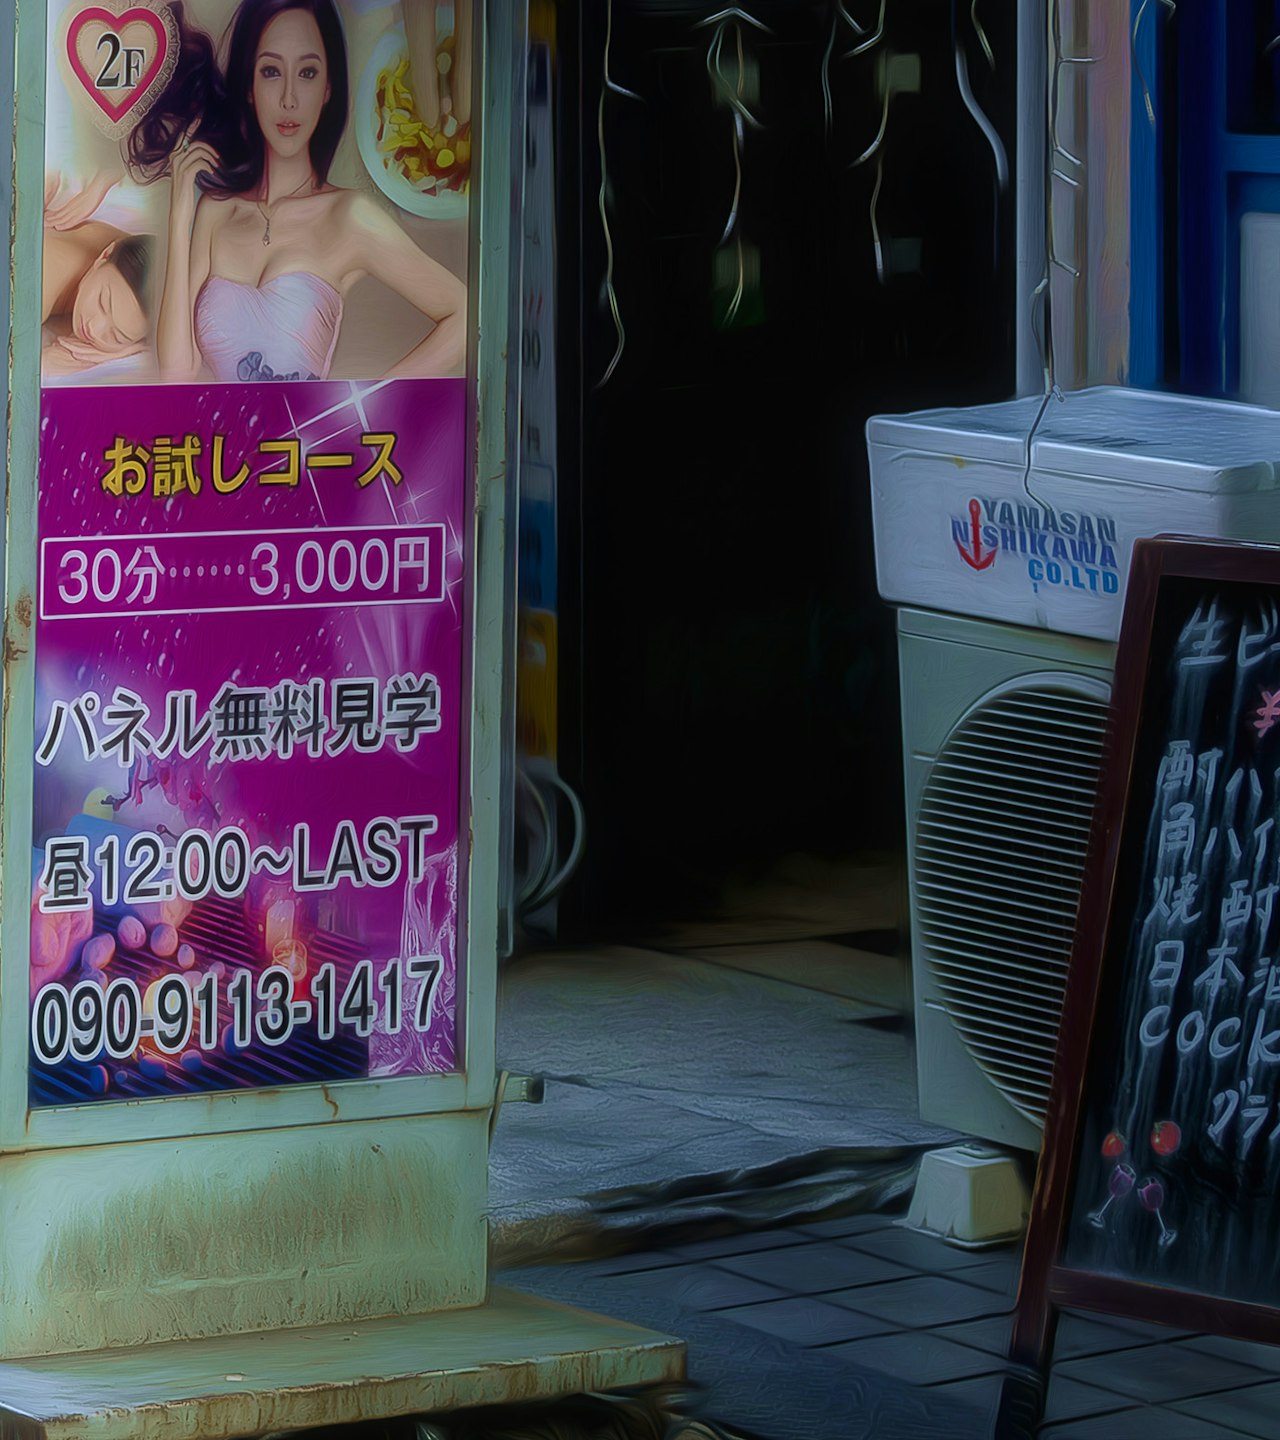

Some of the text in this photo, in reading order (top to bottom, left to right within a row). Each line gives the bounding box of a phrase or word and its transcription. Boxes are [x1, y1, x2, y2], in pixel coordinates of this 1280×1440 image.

[94, 32, 145, 88] 2F
[100, 432, 403, 497] お試しコース
[983, 500, 1117, 542] YAMASAN
[1028, 558, 1118, 595] CO.LTD
[35, 671, 442, 767] パネル無料見学
[1157, 740, 1280, 795] 酎ハ
[32, 954, 444, 1064] 090-9113-1417
[1207, 1077, 1280, 1146] グラ
